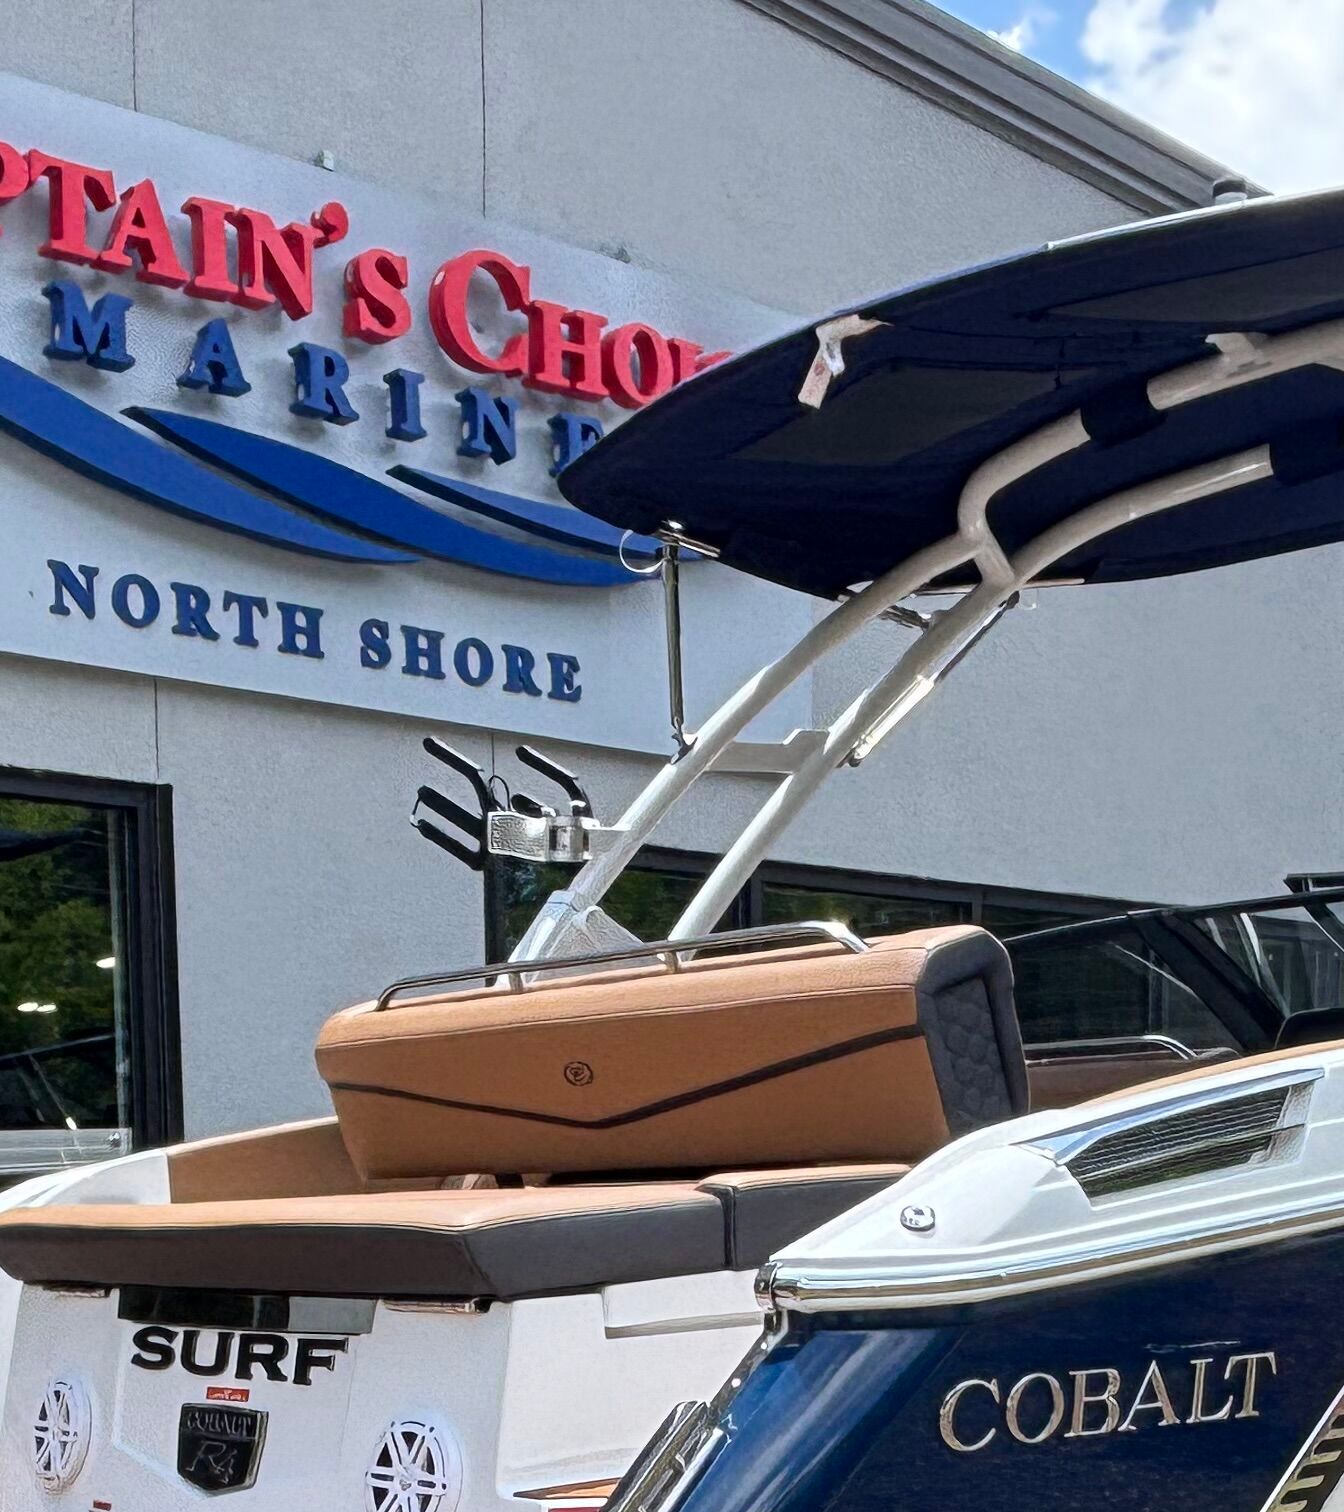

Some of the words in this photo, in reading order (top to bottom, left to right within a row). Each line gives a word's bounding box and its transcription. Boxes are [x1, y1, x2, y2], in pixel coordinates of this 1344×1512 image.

[429, 250, 732, 410] CHOI
[49, 558, 325, 660] NORTH
[359, 617, 583, 703] SHORE
[131, 1325, 349, 1386] SURF
[940, 1351, 1277, 1452] COBALT
